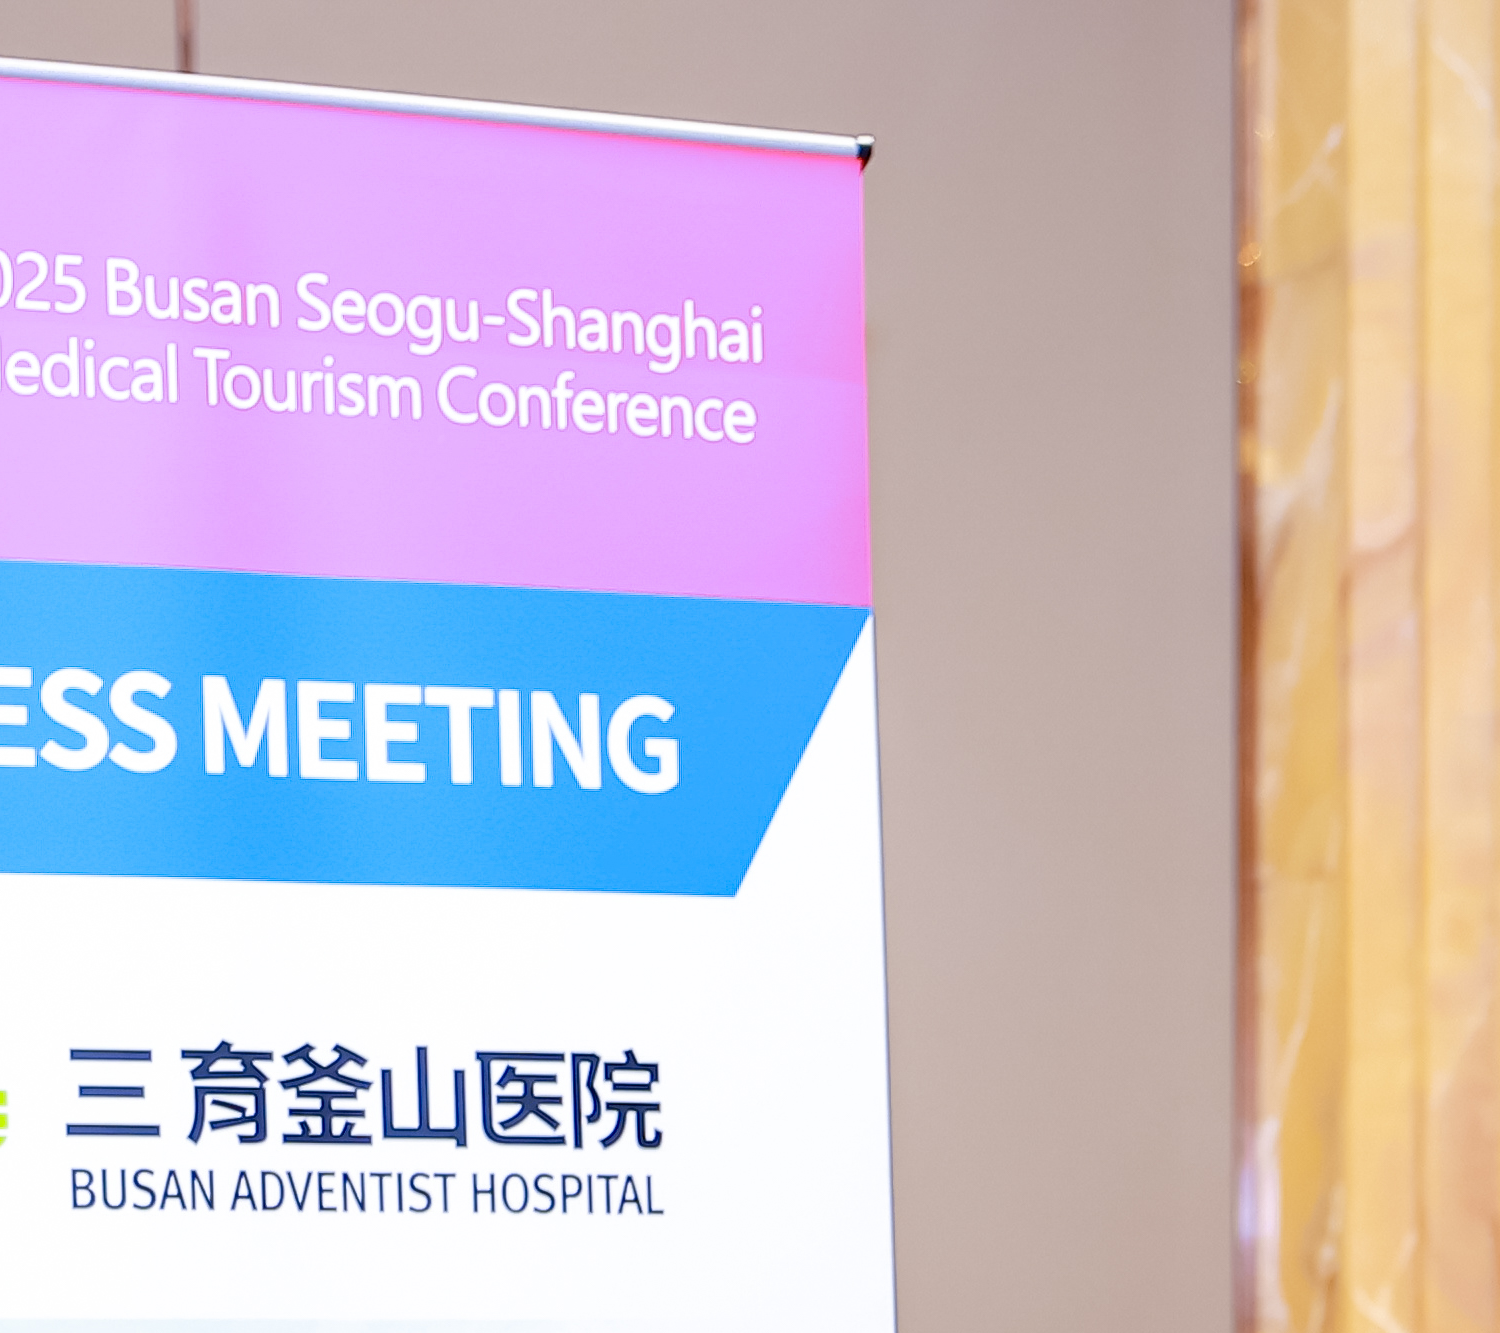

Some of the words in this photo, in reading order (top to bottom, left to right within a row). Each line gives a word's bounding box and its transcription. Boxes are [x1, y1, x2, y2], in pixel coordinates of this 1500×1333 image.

[107, 258, 279, 327] Busan
[298, 273, 762, 372] Seogu-Shanghai
[194, 348, 422, 419] Tourism
[436, 365, 755, 443] Conference
[203, 675, 679, 793] MEETING
[66, 1040, 662, 1149] 三育釜山医院
[72, 1169, 214, 1210] BUSAN
[231, 1171, 455, 1212] ADVENTIST
[473, 1173, 663, 1214] HOSPITAL
